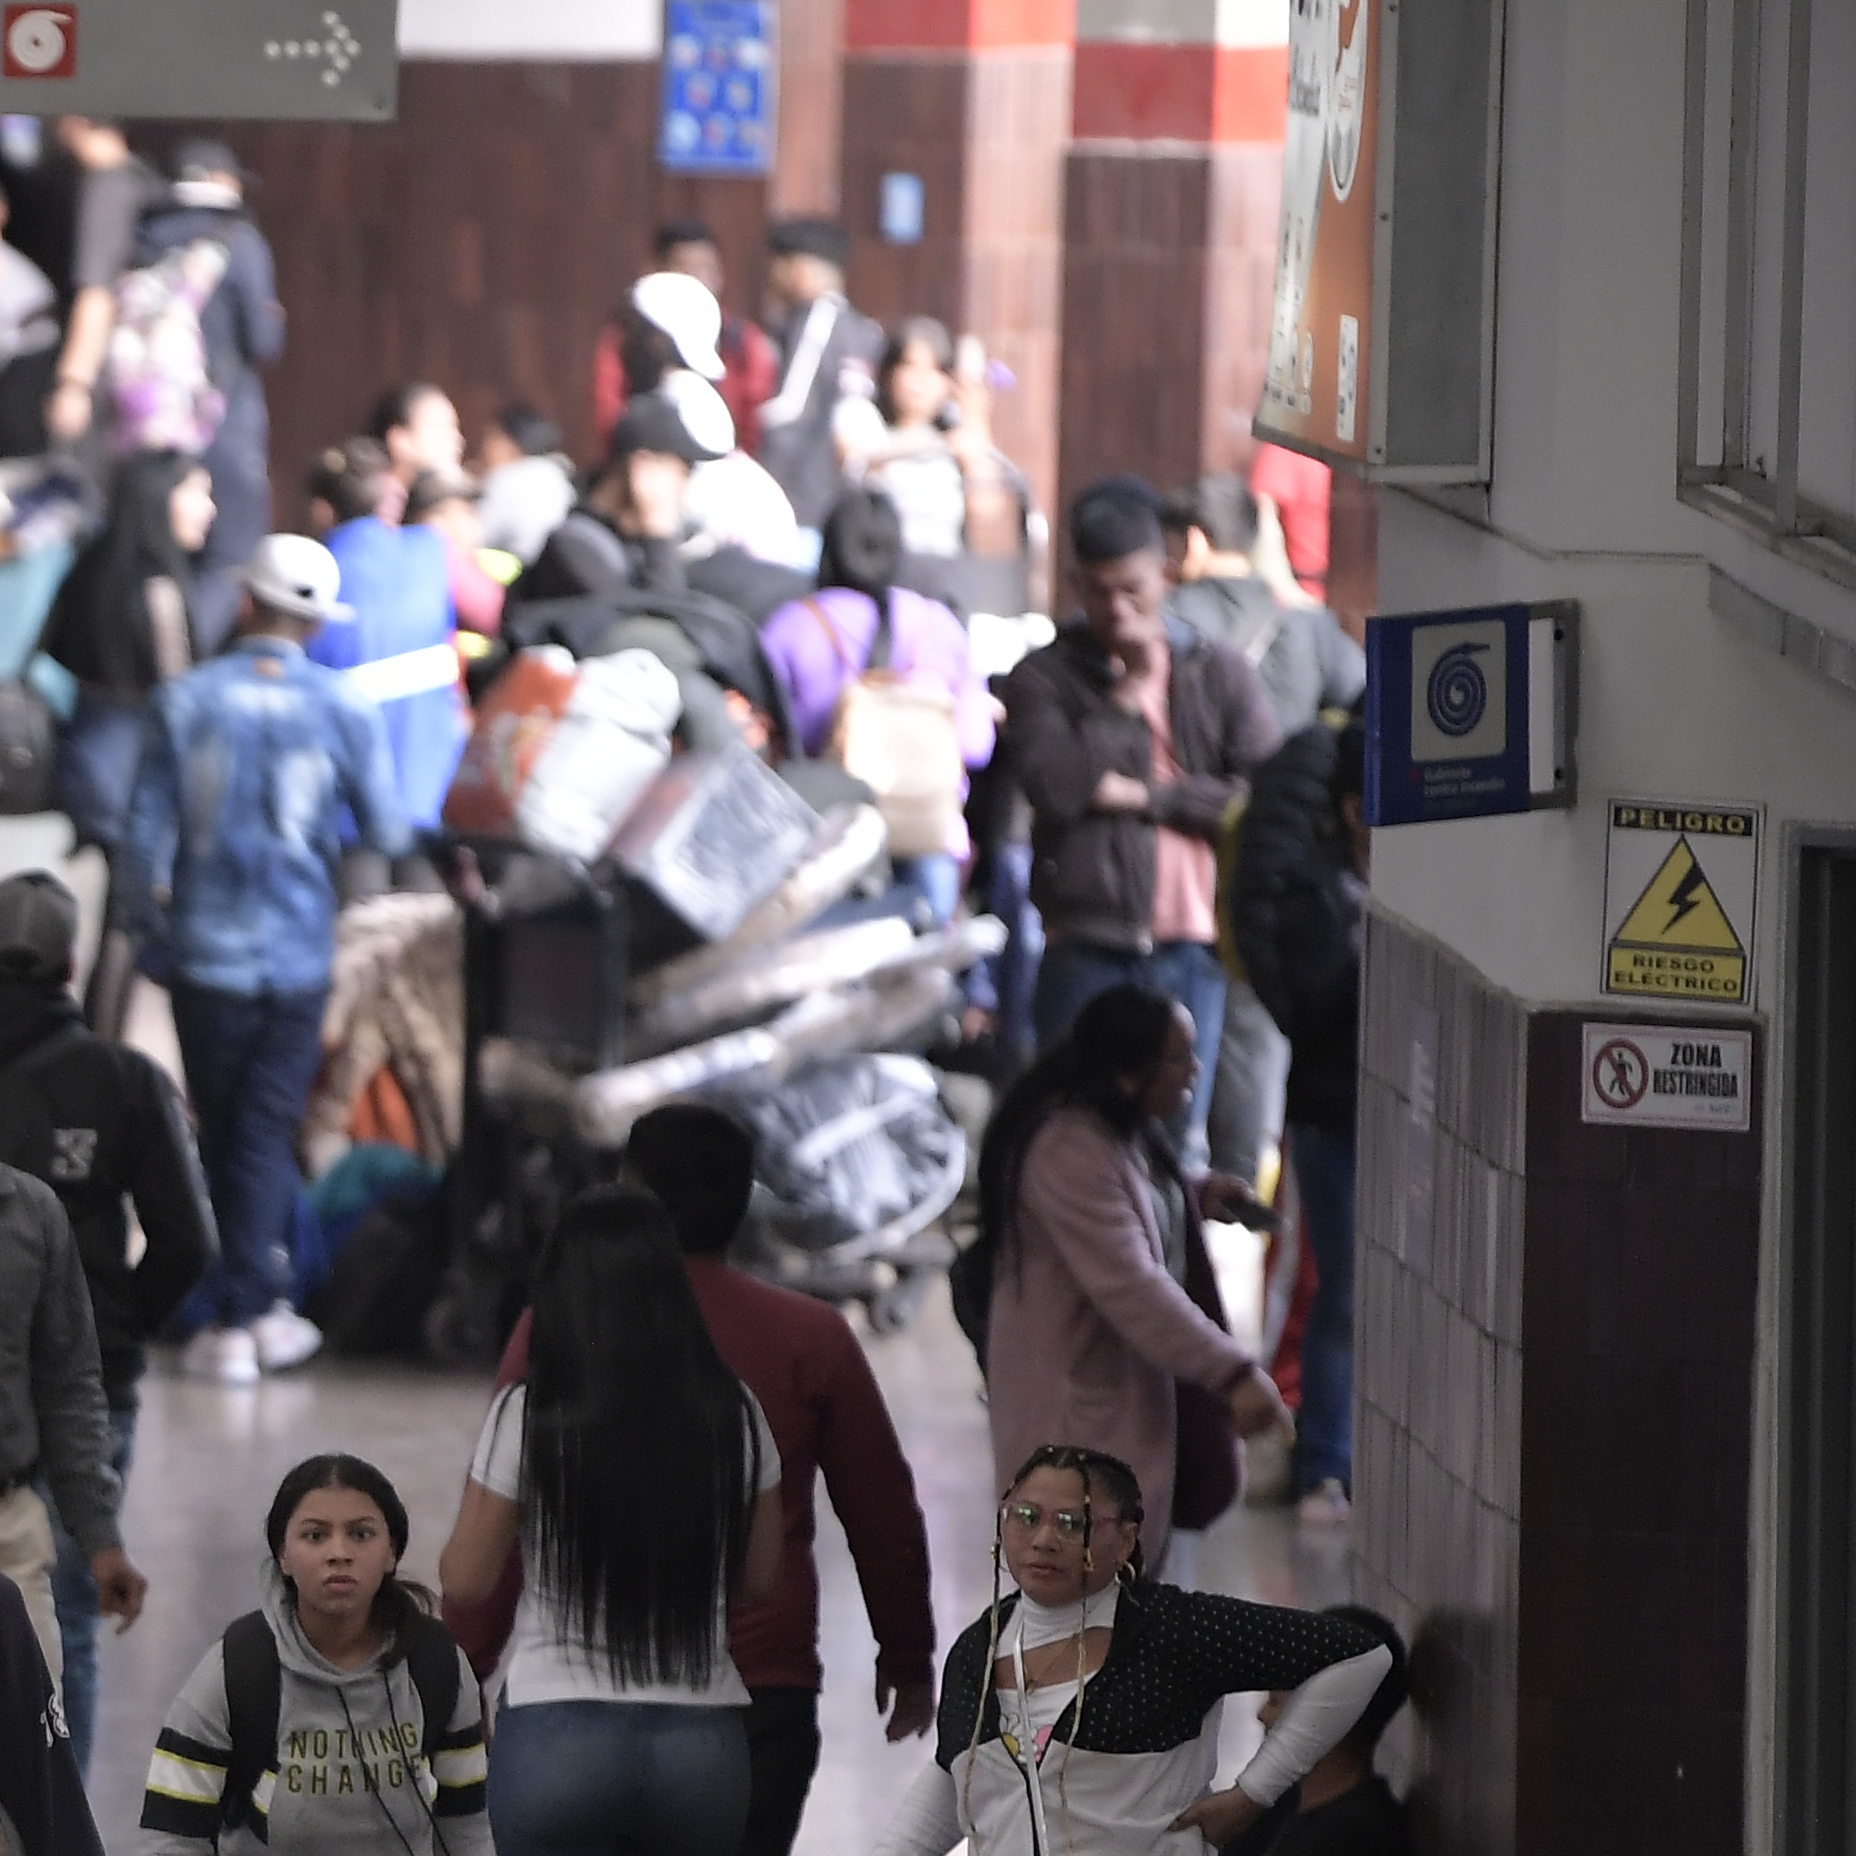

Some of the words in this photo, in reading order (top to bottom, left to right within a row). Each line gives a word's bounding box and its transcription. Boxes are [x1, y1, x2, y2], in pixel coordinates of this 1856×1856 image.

[1620, 807, 1745, 834] PELIGRO
[1632, 953, 1715, 974] RIESGO
[1670, 1042, 1723, 1068] ZONA
[1652, 1067, 1738, 1098] RESTRINGIDA
[289, 1721, 418, 1760] NOTHING
